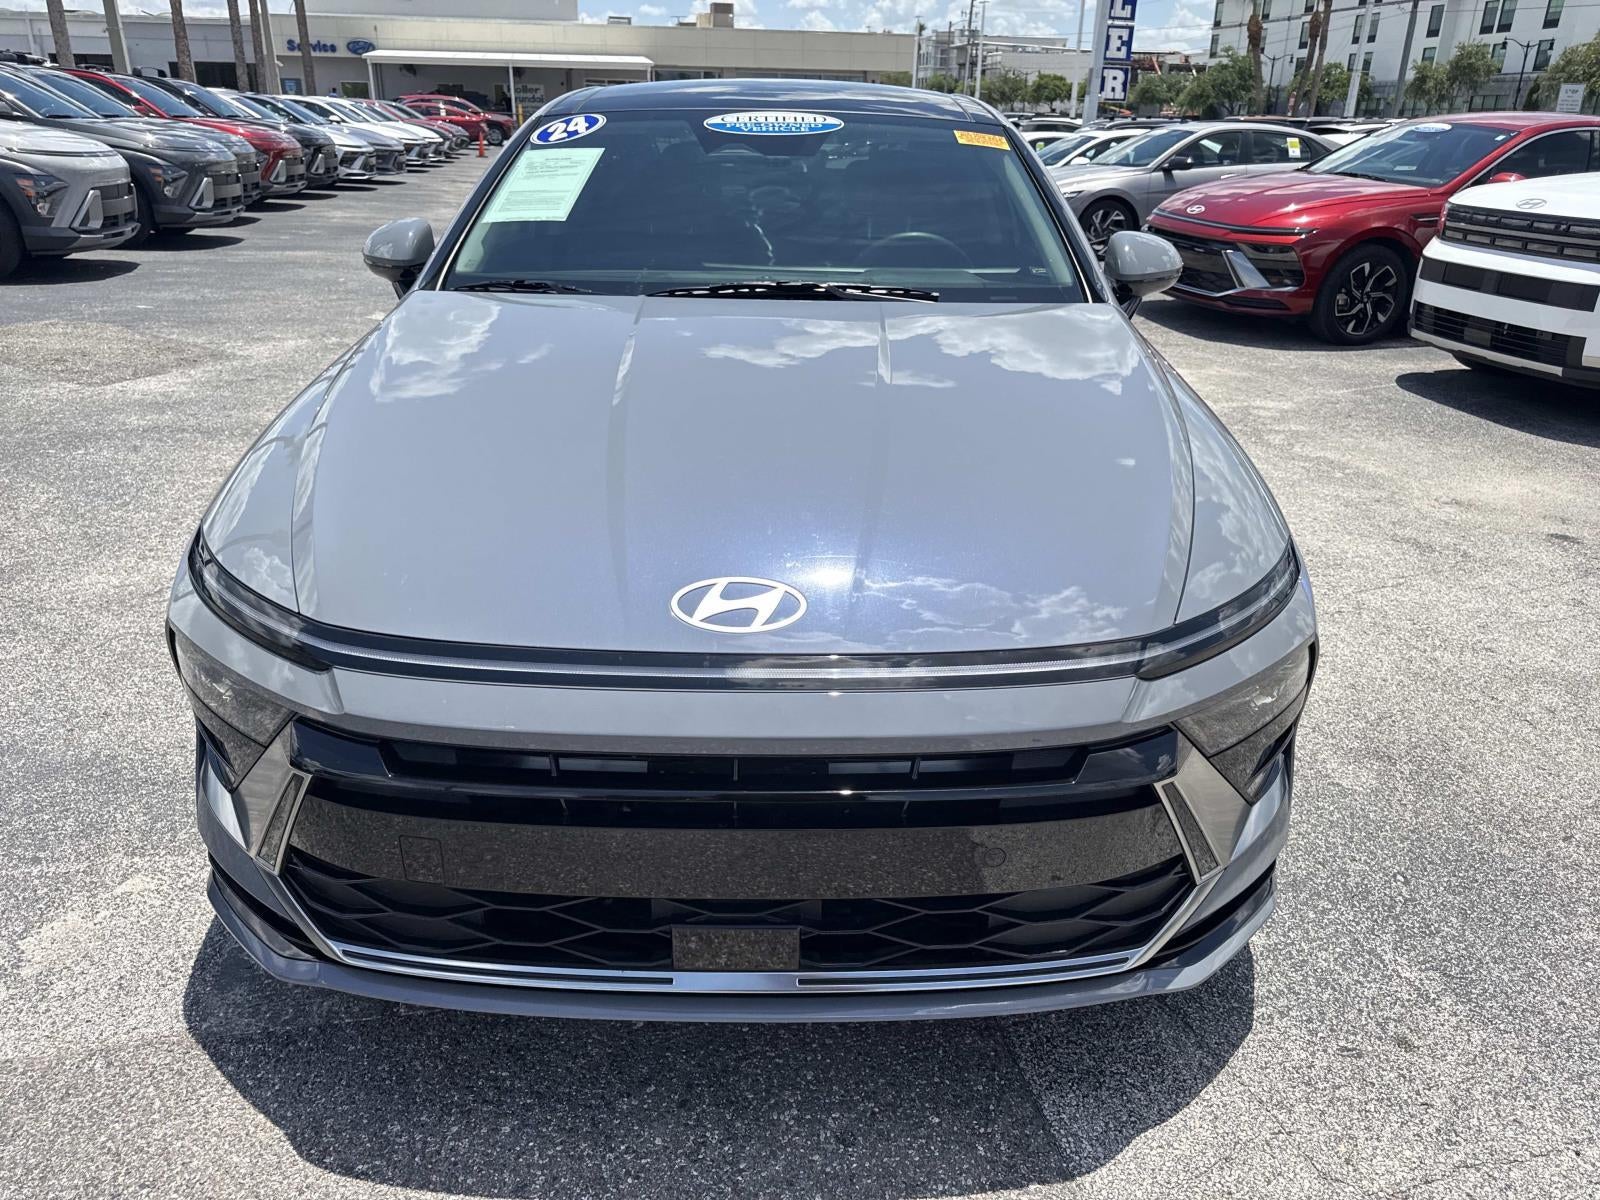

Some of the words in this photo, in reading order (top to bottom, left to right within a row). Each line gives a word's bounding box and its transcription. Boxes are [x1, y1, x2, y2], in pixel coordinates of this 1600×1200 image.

[287, 39, 337, 53] Sevice
[721, 115, 827, 123] CERTIFIED
[547, 116, 589, 142] 24
